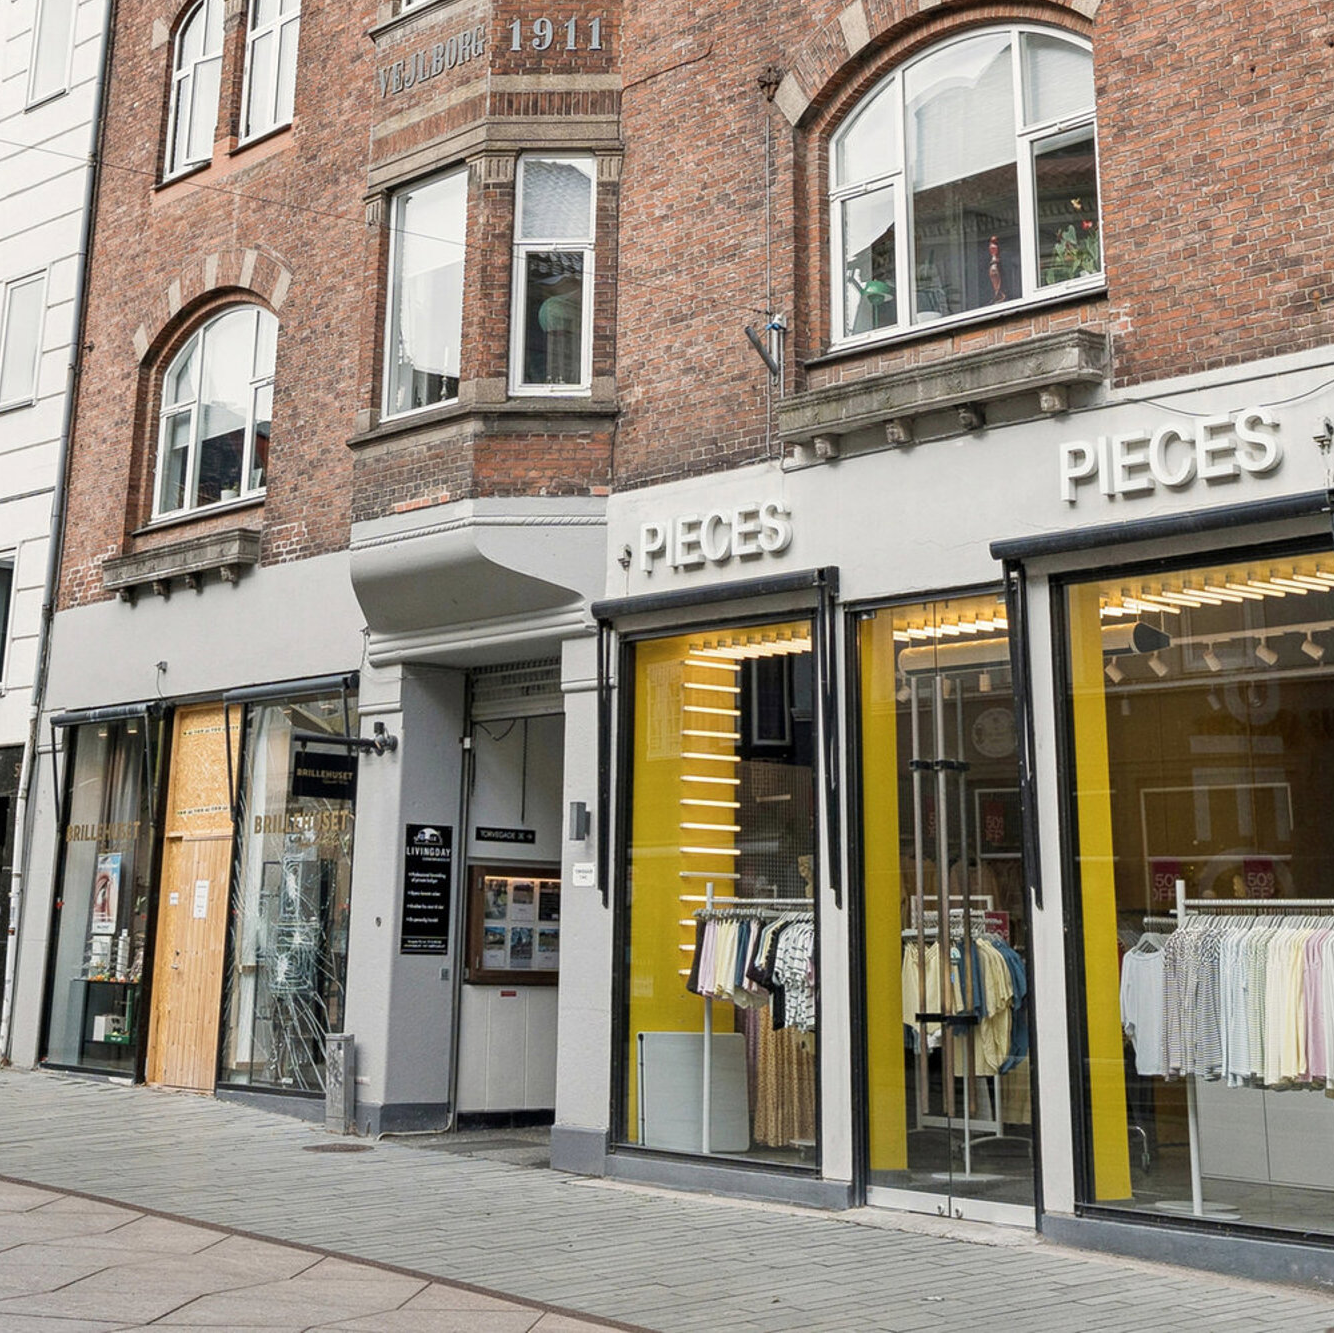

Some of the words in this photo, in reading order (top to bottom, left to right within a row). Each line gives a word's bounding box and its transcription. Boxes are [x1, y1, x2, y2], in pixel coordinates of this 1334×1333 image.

[508, 16, 603, 52] 1911
[379, 24, 486, 98] VEJLBORG
[1059, 406, 1284, 505] PIECES
[640, 498, 793, 574] PIECES
[296, 767, 353, 780] BRILLEHUSET
[66, 820, 140, 842] BRILLEHUSET
[254, 809, 350, 834] BRILLEHUSET
[406, 846, 451, 857] LIVINGDAY
